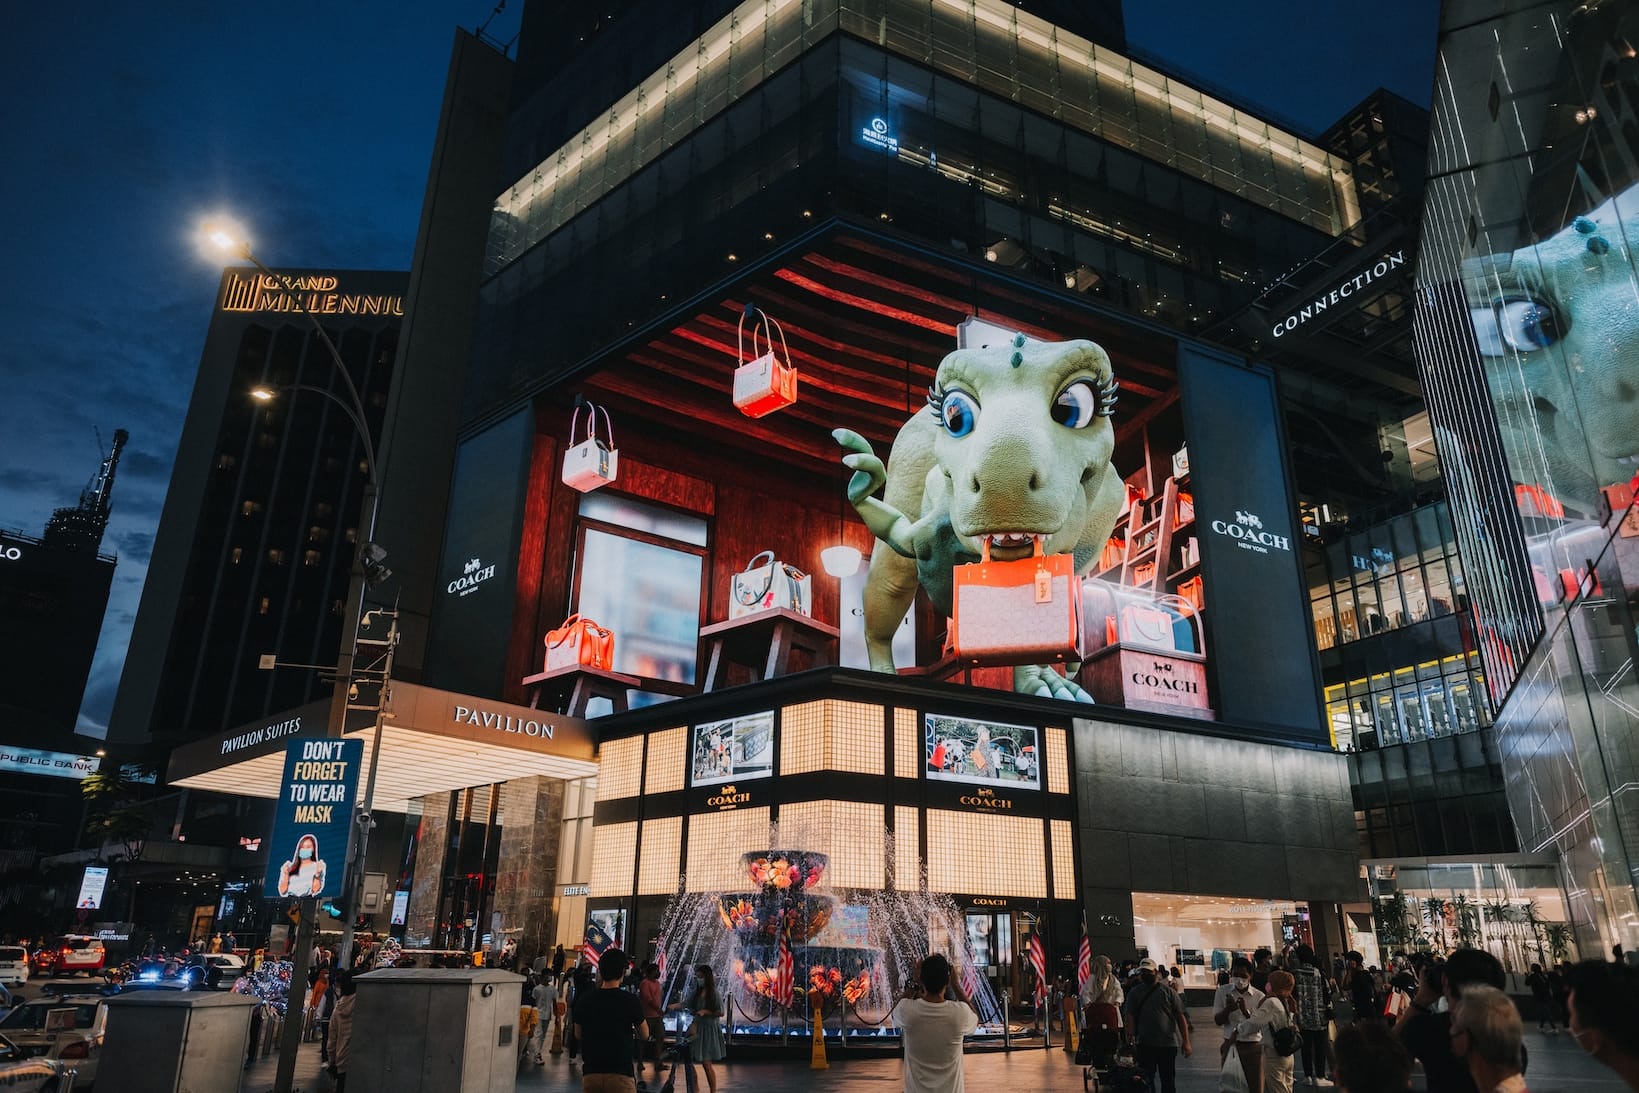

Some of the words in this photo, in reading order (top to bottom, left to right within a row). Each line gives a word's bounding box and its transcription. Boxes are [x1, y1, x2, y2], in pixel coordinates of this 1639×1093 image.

[263, 274, 338, 291] GRAND
[1272, 250, 1405, 338] CONNECTION
[1211, 520, 1290, 551] COACH
[1238, 541, 1253, 551] NEW
[1252, 545, 1268, 554] YORK
[447, 564, 496, 594] COACH
[1132, 672, 1198, 694] COACH
[454, 705, 555, 740] PAVILION
[221, 729, 264, 755] PAVILION
[265, 717, 301, 741] SUITES
[303, 741, 345, 760] DON'T
[0, 753, 50, 766] PUBLIC
[55, 760, 93, 771] BANK
[293, 762, 348, 781] FORGET
[290, 784, 306, 802] TO
[309, 784, 346, 802] WEAR
[707, 792, 751, 806] COACH
[959, 795, 1012, 809] COACH
[294, 805, 333, 823] MASK
[972, 898, 1007, 906] COACH
